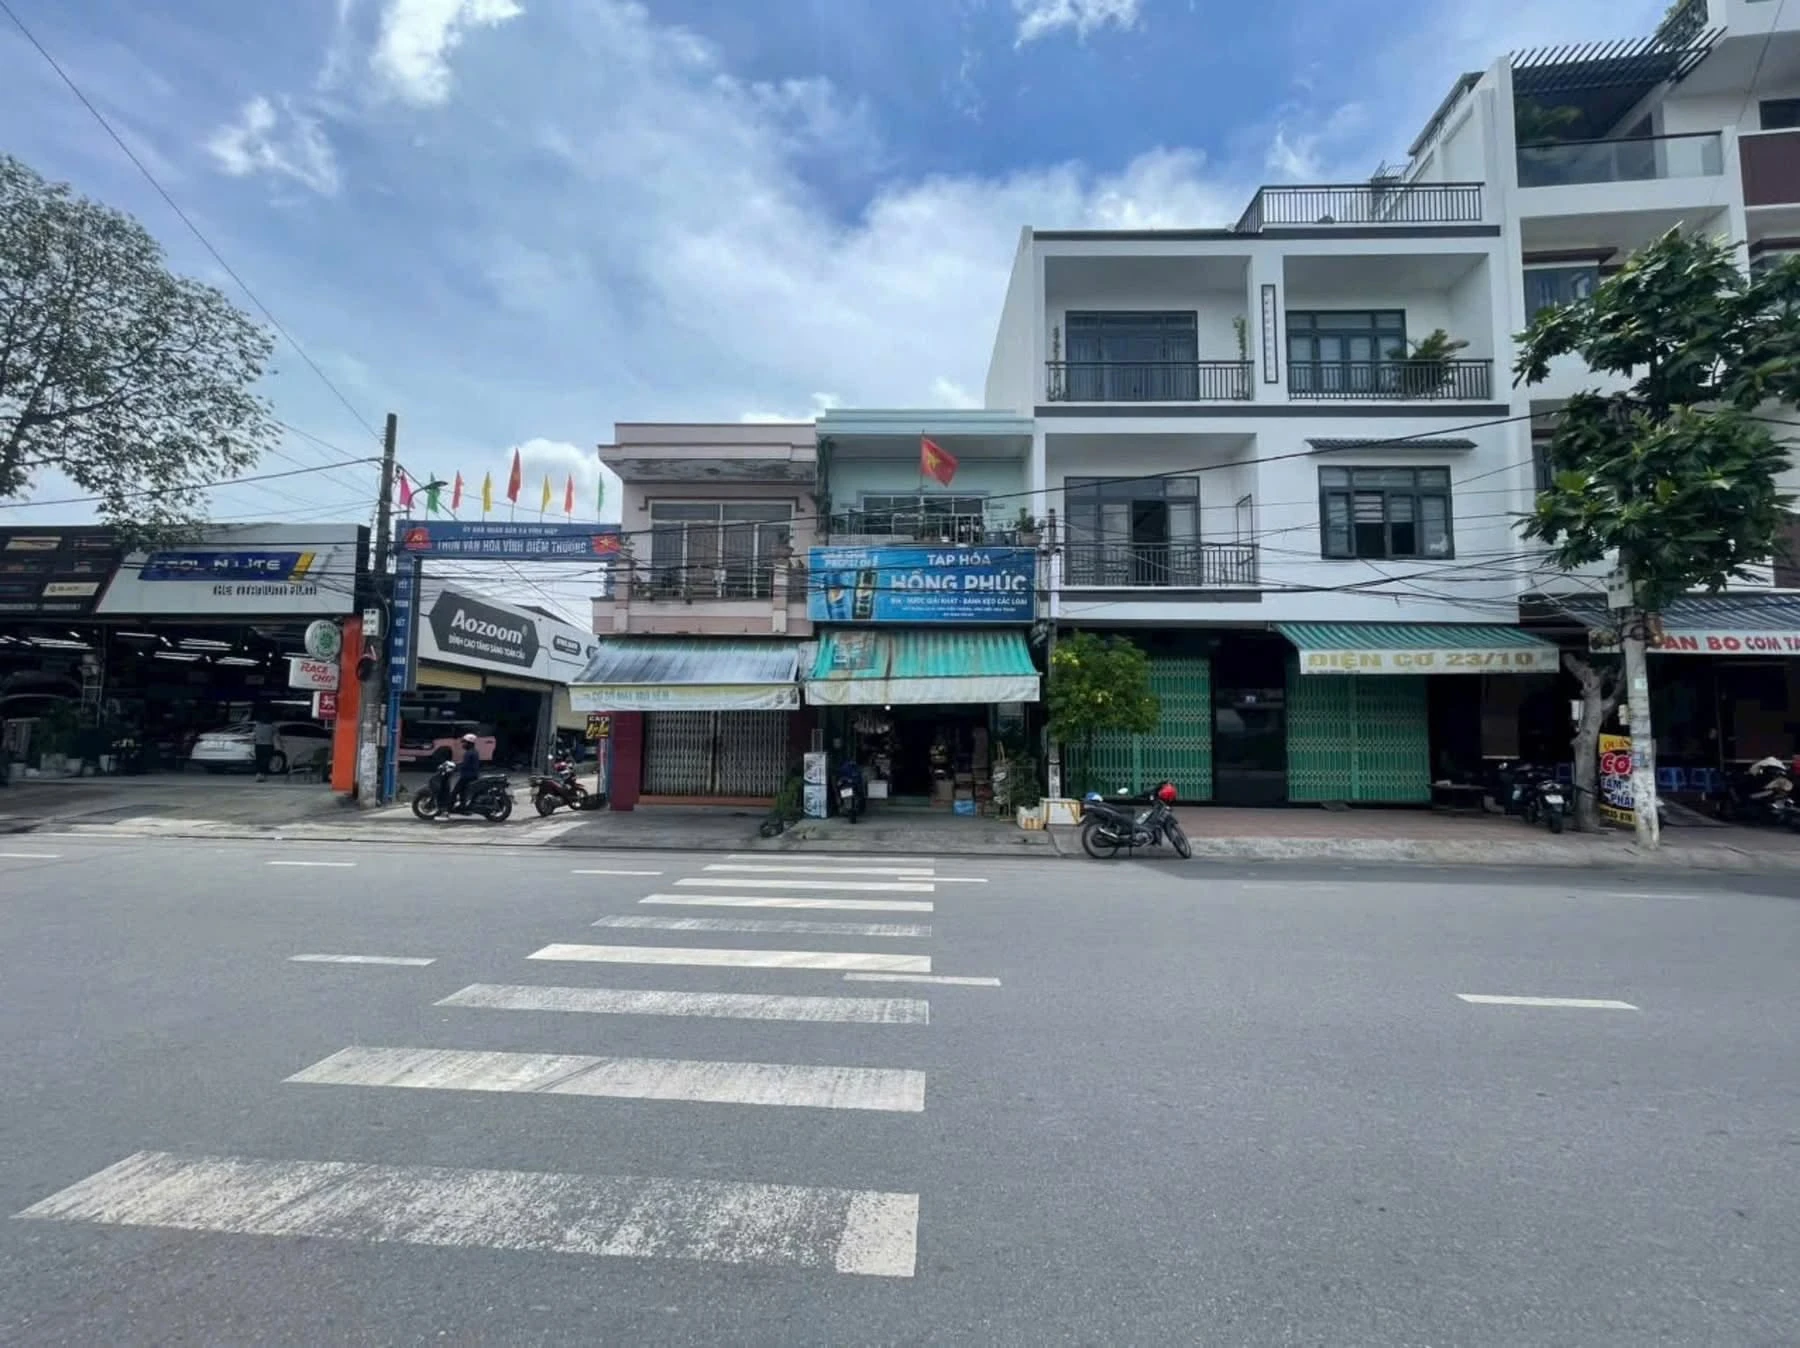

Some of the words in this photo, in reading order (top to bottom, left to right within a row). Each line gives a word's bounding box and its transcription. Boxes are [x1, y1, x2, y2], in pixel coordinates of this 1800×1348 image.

[959, 552, 992, 565] HÓA
[890, 569, 958, 595] HỒNG
[964, 570, 1028, 595] PHÚC
[451, 608, 523, 645] Aozoom
[1706, 636, 1742, 651] BO
[300, 662, 329, 673] RACE
[1307, 652, 1382, 670] ĐIỆN
[1446, 652, 1535, 667] 23/10
